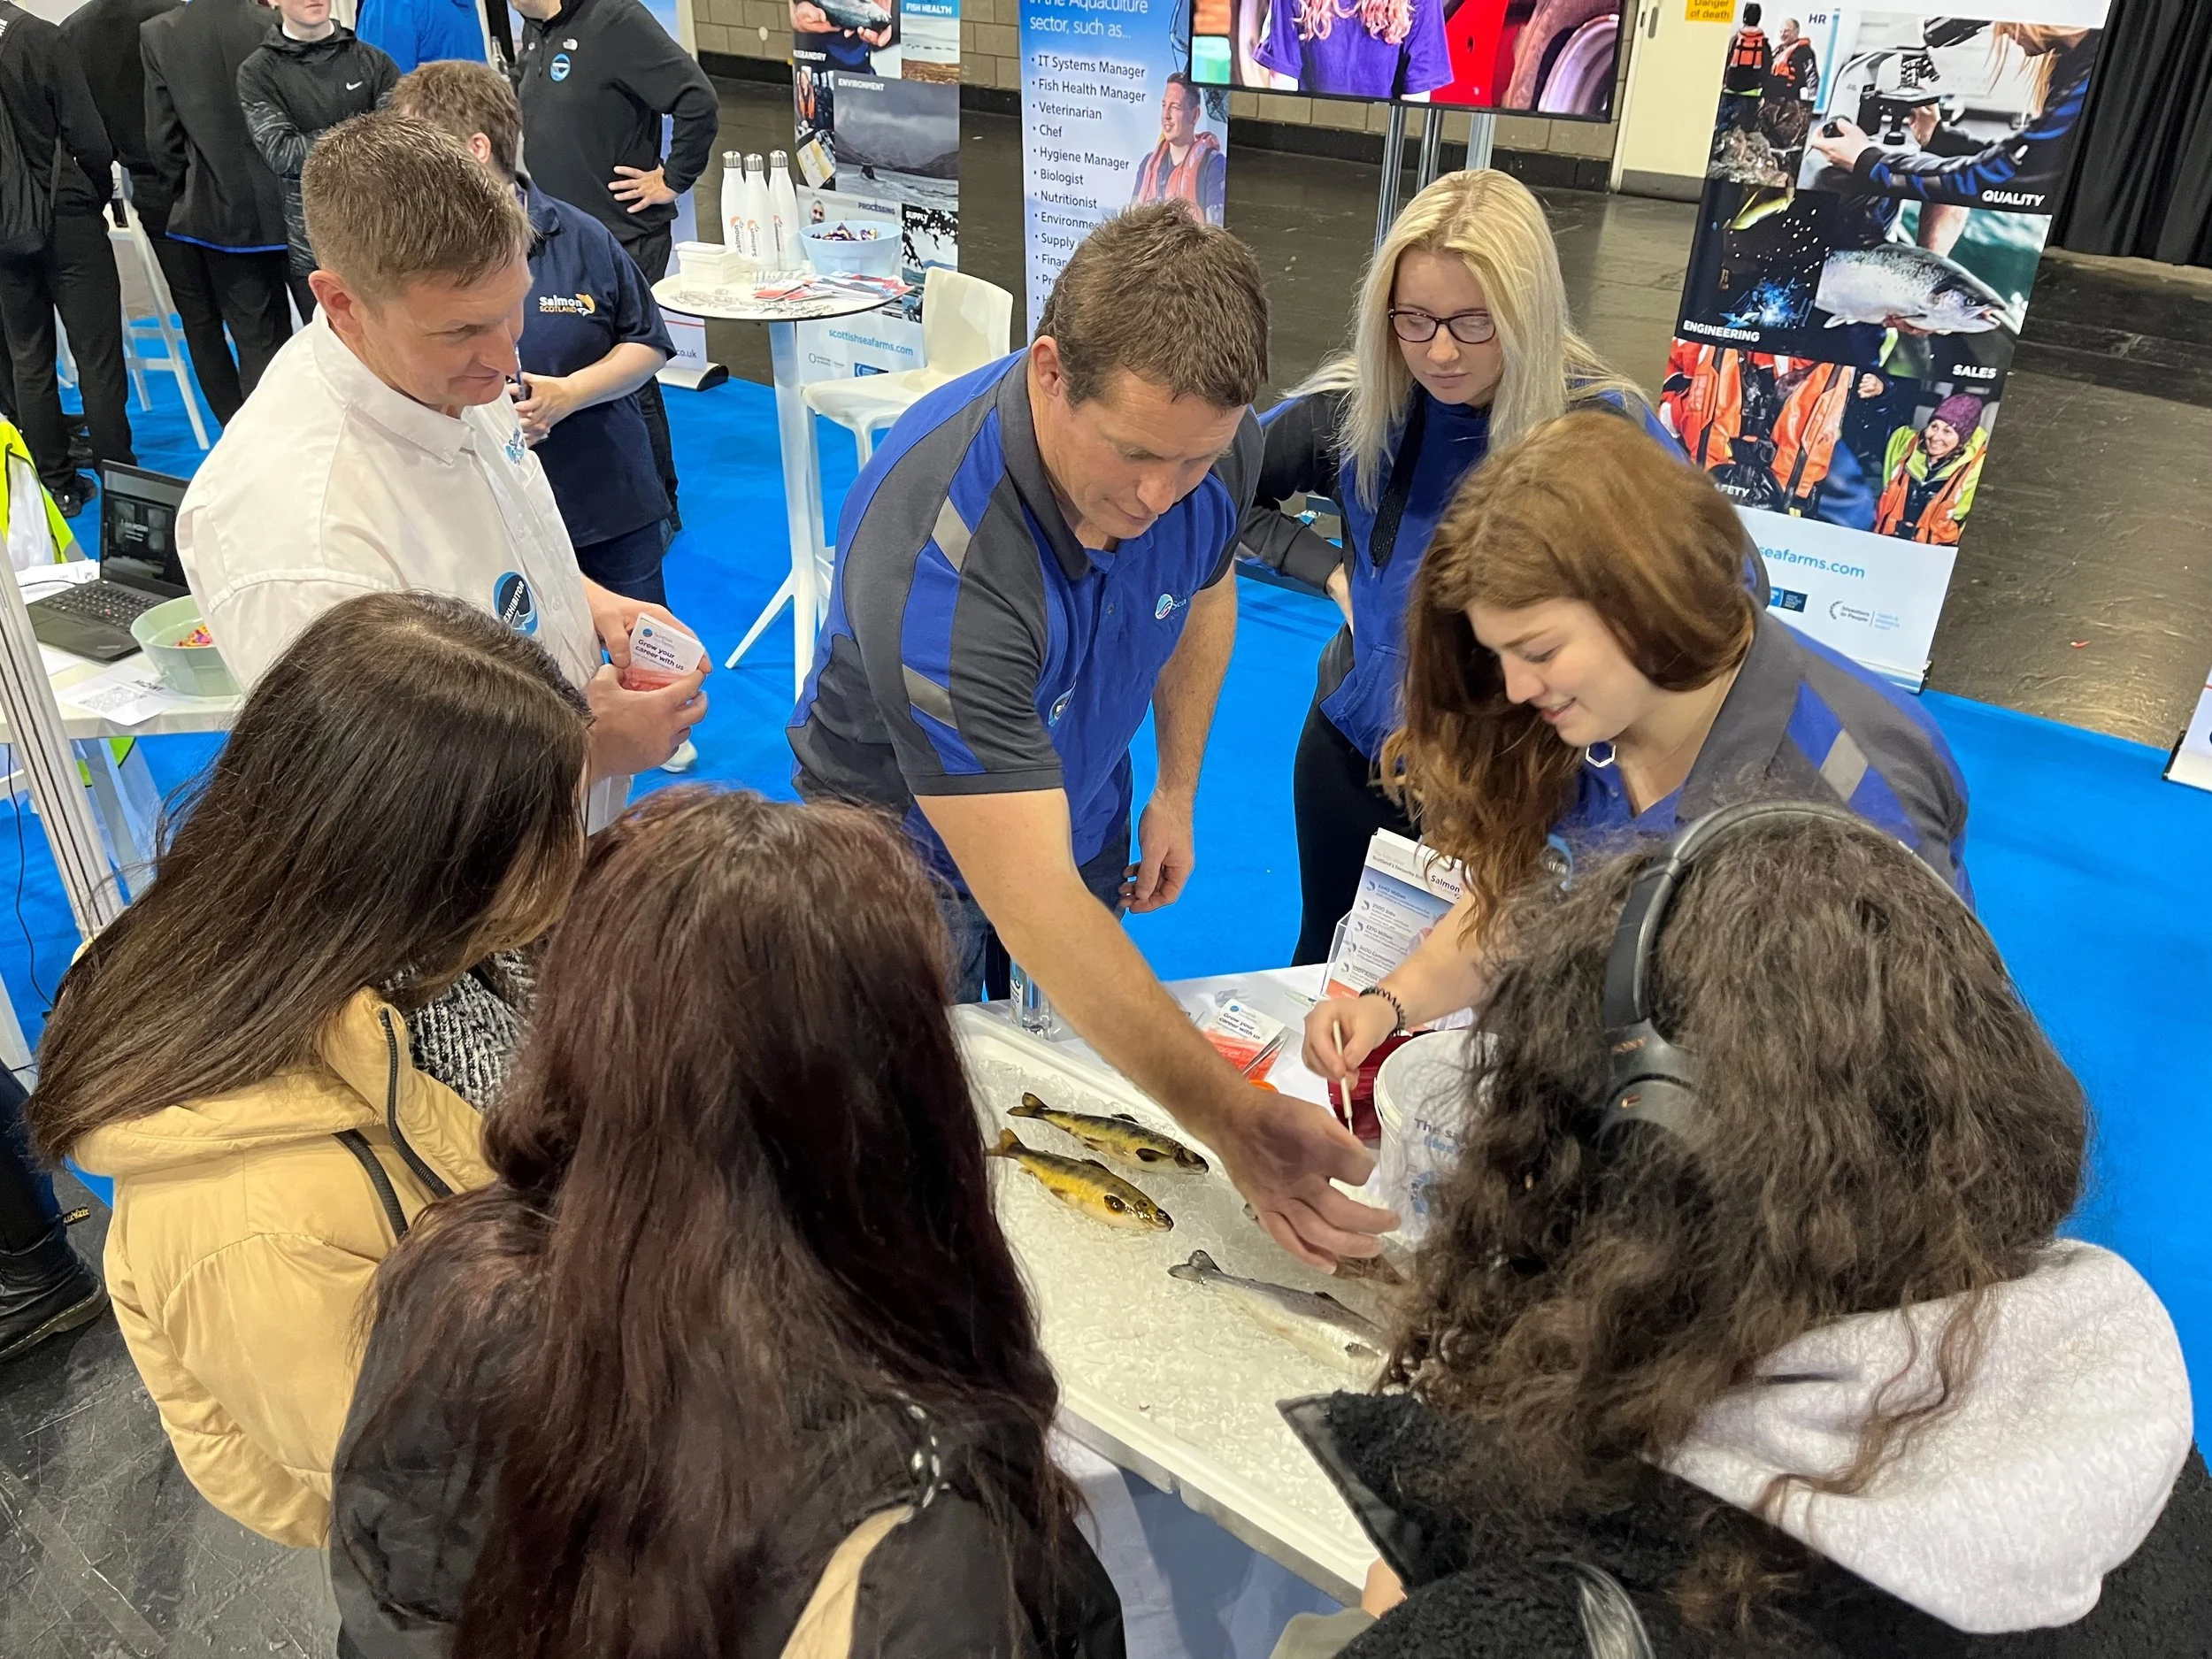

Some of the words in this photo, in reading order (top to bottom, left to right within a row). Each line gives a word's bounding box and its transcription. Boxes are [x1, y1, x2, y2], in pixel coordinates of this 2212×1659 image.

[906, 3, 921, 13] FISH
[922, 4, 952, 15] HEALTH
[1690, 10, 1701, 19] of
[1702, 9, 1730, 19] death
[1030, 16, 1070, 35] sector,
[1073, 18, 1104, 36] such
[1108, 23, 1132, 39] as...
[1809, 14, 1827, 25] HR
[1038, 55, 1049, 67] IT
[1052, 56, 1096, 72] Systems
[1099, 61, 1146, 80] Manager
[838, 78, 885, 92] ENVIRONMENT
[1039, 78, 1059, 92] Fish
[1062, 81, 1097, 96] Health
[1100, 85, 1147, 104] Manager
[1039, 101, 1102, 120] Veterinarian
[1039, 124, 1063, 137] Chef
[1040, 146, 1081, 163] Hygiene
[1084, 152, 1130, 171] Manager
[1041, 168, 1084, 186] Biologist
[1041, 190, 1097, 210] Nutritionist
[1981, 189, 2046, 207] QUALITY
[858, 202, 896, 215] PROCESSING
[905, 211, 929, 224] SUPPLY
[1041, 233, 1075, 250] Supply
[539, 294, 583, 308] Salmon
[1683, 319, 1761, 342] ENGINEERING
[828, 328, 914, 357] scottishseafarms.com
[1952, 364, 1997, 380] SALES
[503, 580, 525, 625] EXHIBITOR
[635, 645, 657, 658] career
[659, 655, 675, 668] with
[638, 639, 657, 651] Grow
[658, 648, 676, 660] your
[1430, 874, 1461, 893] Salmon
[1218, 1017, 1239, 1029] career
[1223, 1012, 1240, 1024] Grow
[1239, 1020, 1256, 1031] your
[1414, 1118, 1441, 1136] The
